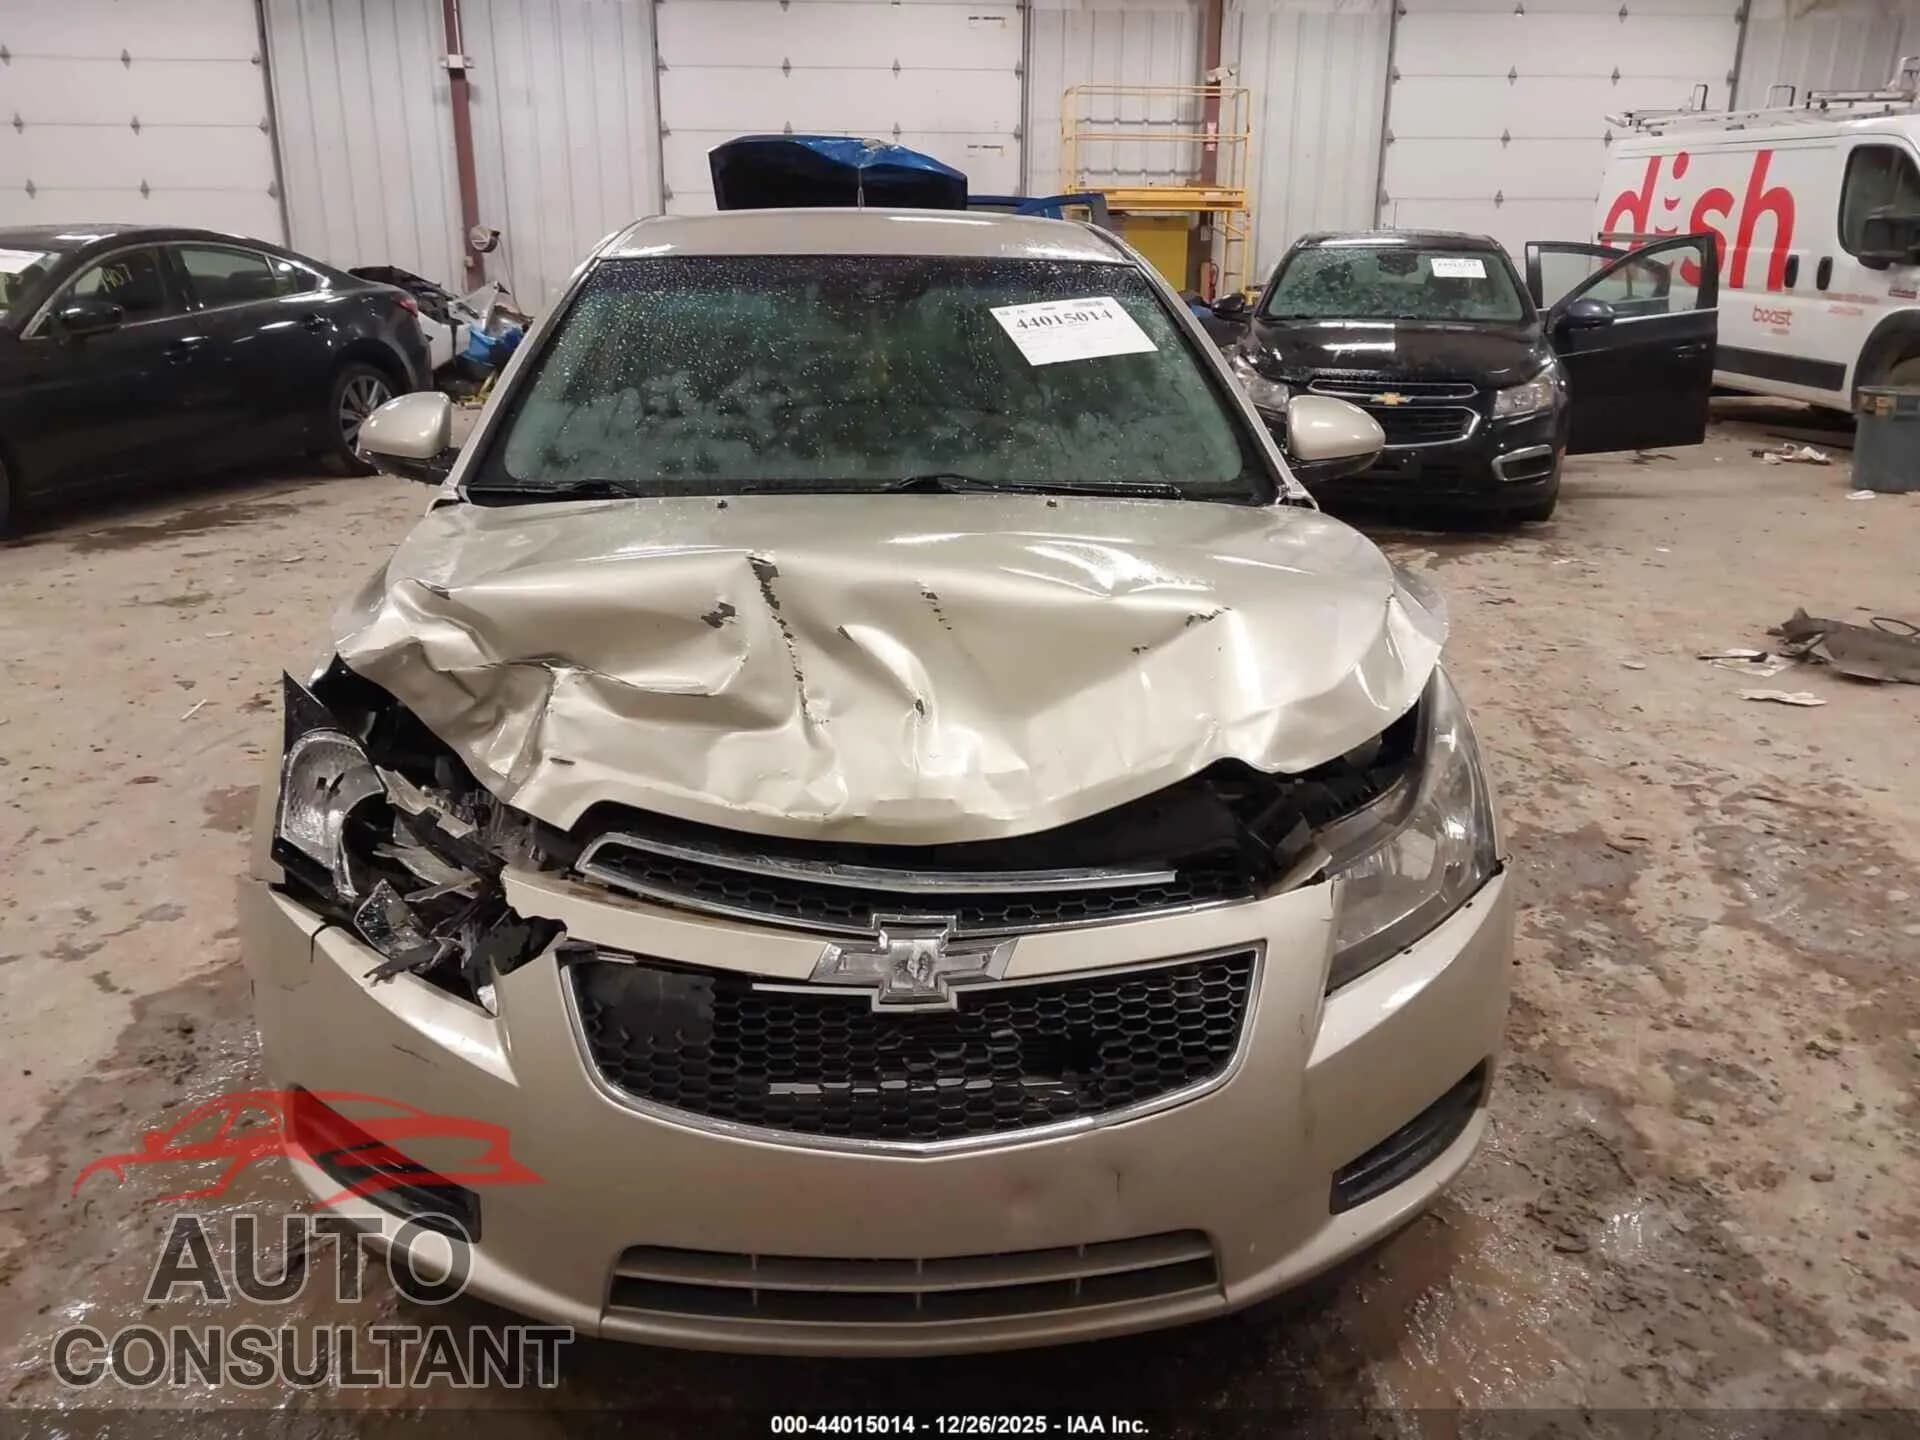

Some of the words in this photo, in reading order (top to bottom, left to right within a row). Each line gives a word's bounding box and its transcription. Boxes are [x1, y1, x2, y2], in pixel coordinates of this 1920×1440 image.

[1602, 149, 1794, 292] dish
[1016, 309, 1113, 329] 44015014
[1752, 304, 1792, 326] boost
